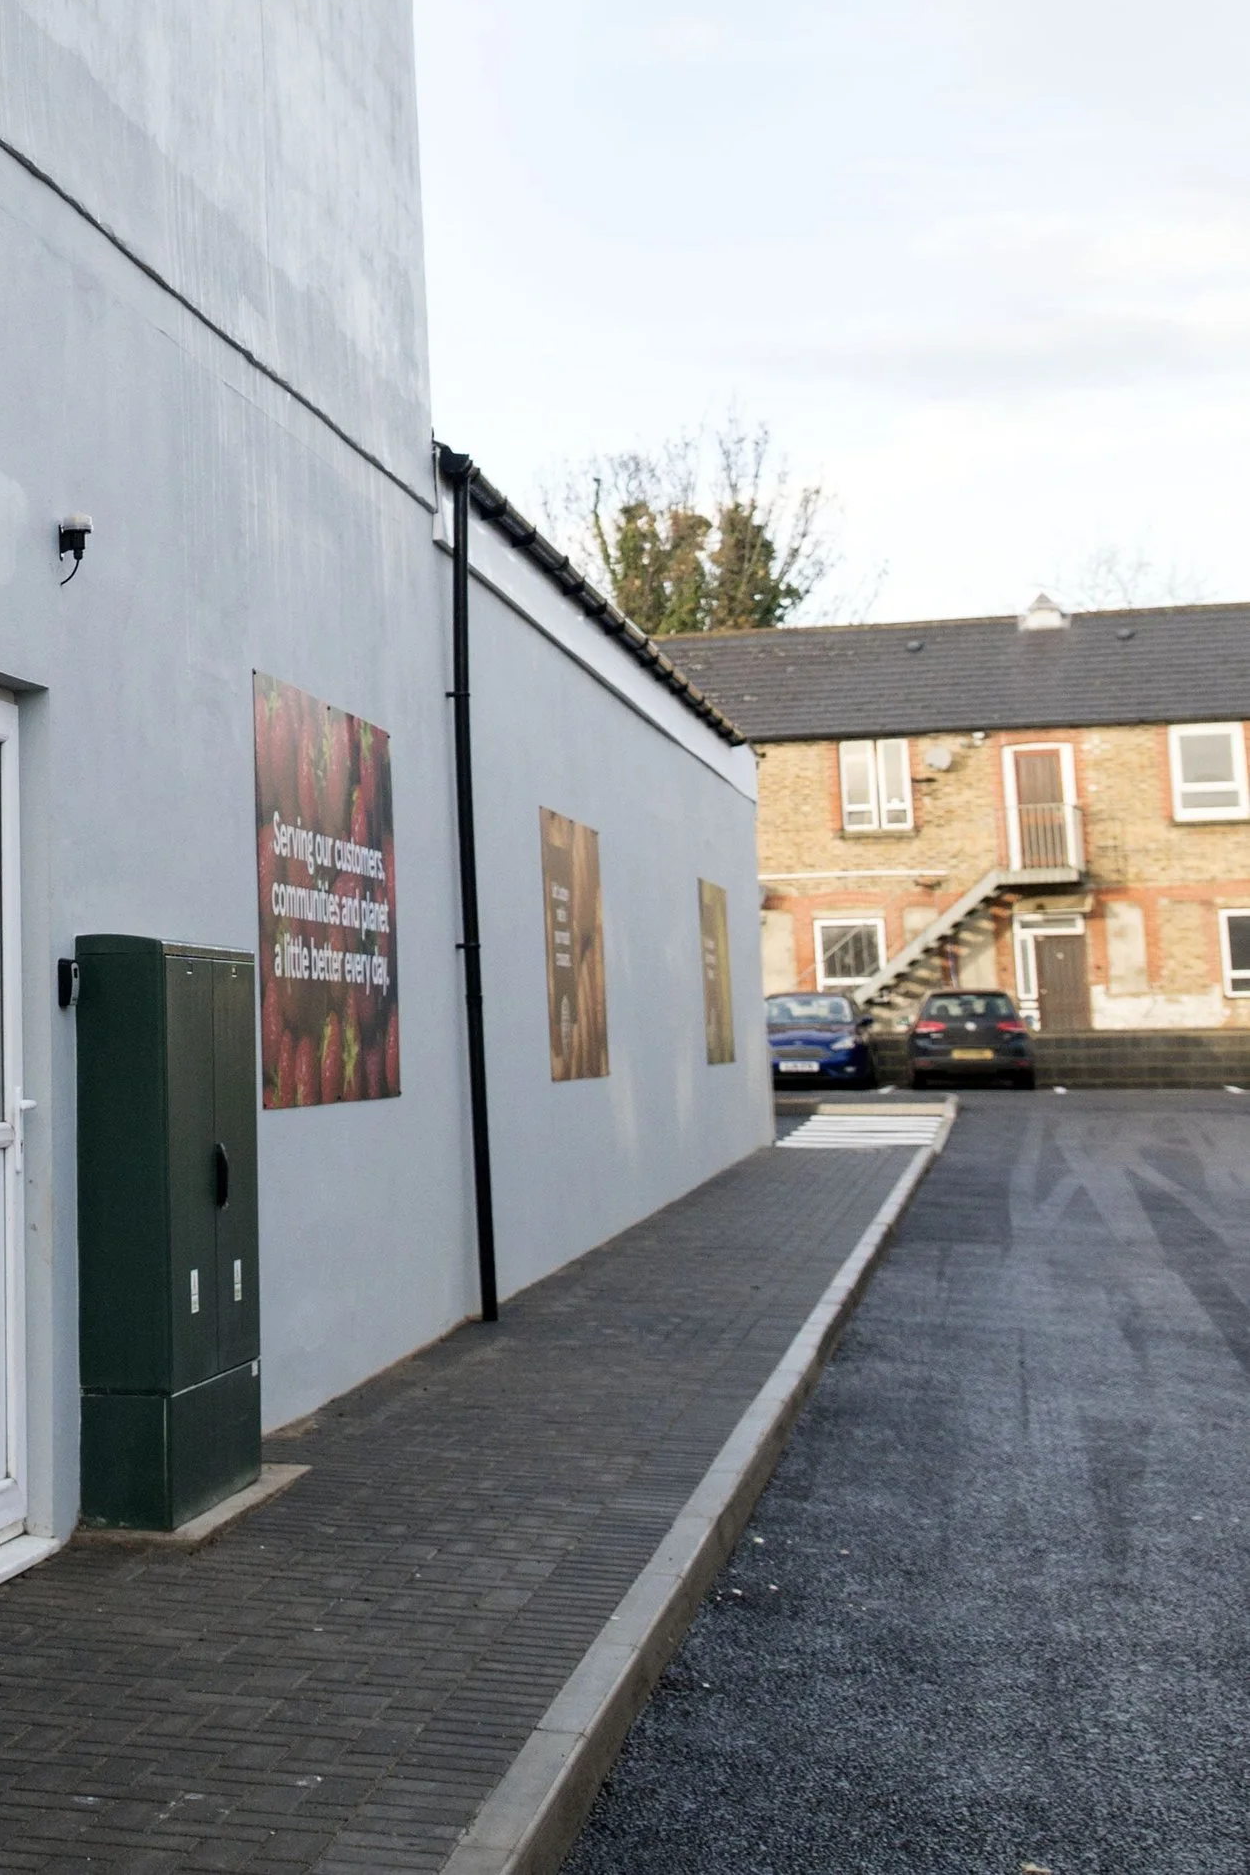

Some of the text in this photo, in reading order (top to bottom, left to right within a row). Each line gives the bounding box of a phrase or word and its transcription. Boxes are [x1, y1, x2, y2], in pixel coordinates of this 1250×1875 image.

[273, 811, 386, 886] Serving our customers,
[272, 880, 390, 940] communities and planet
[274, 933, 390, 996] a little better every day.
